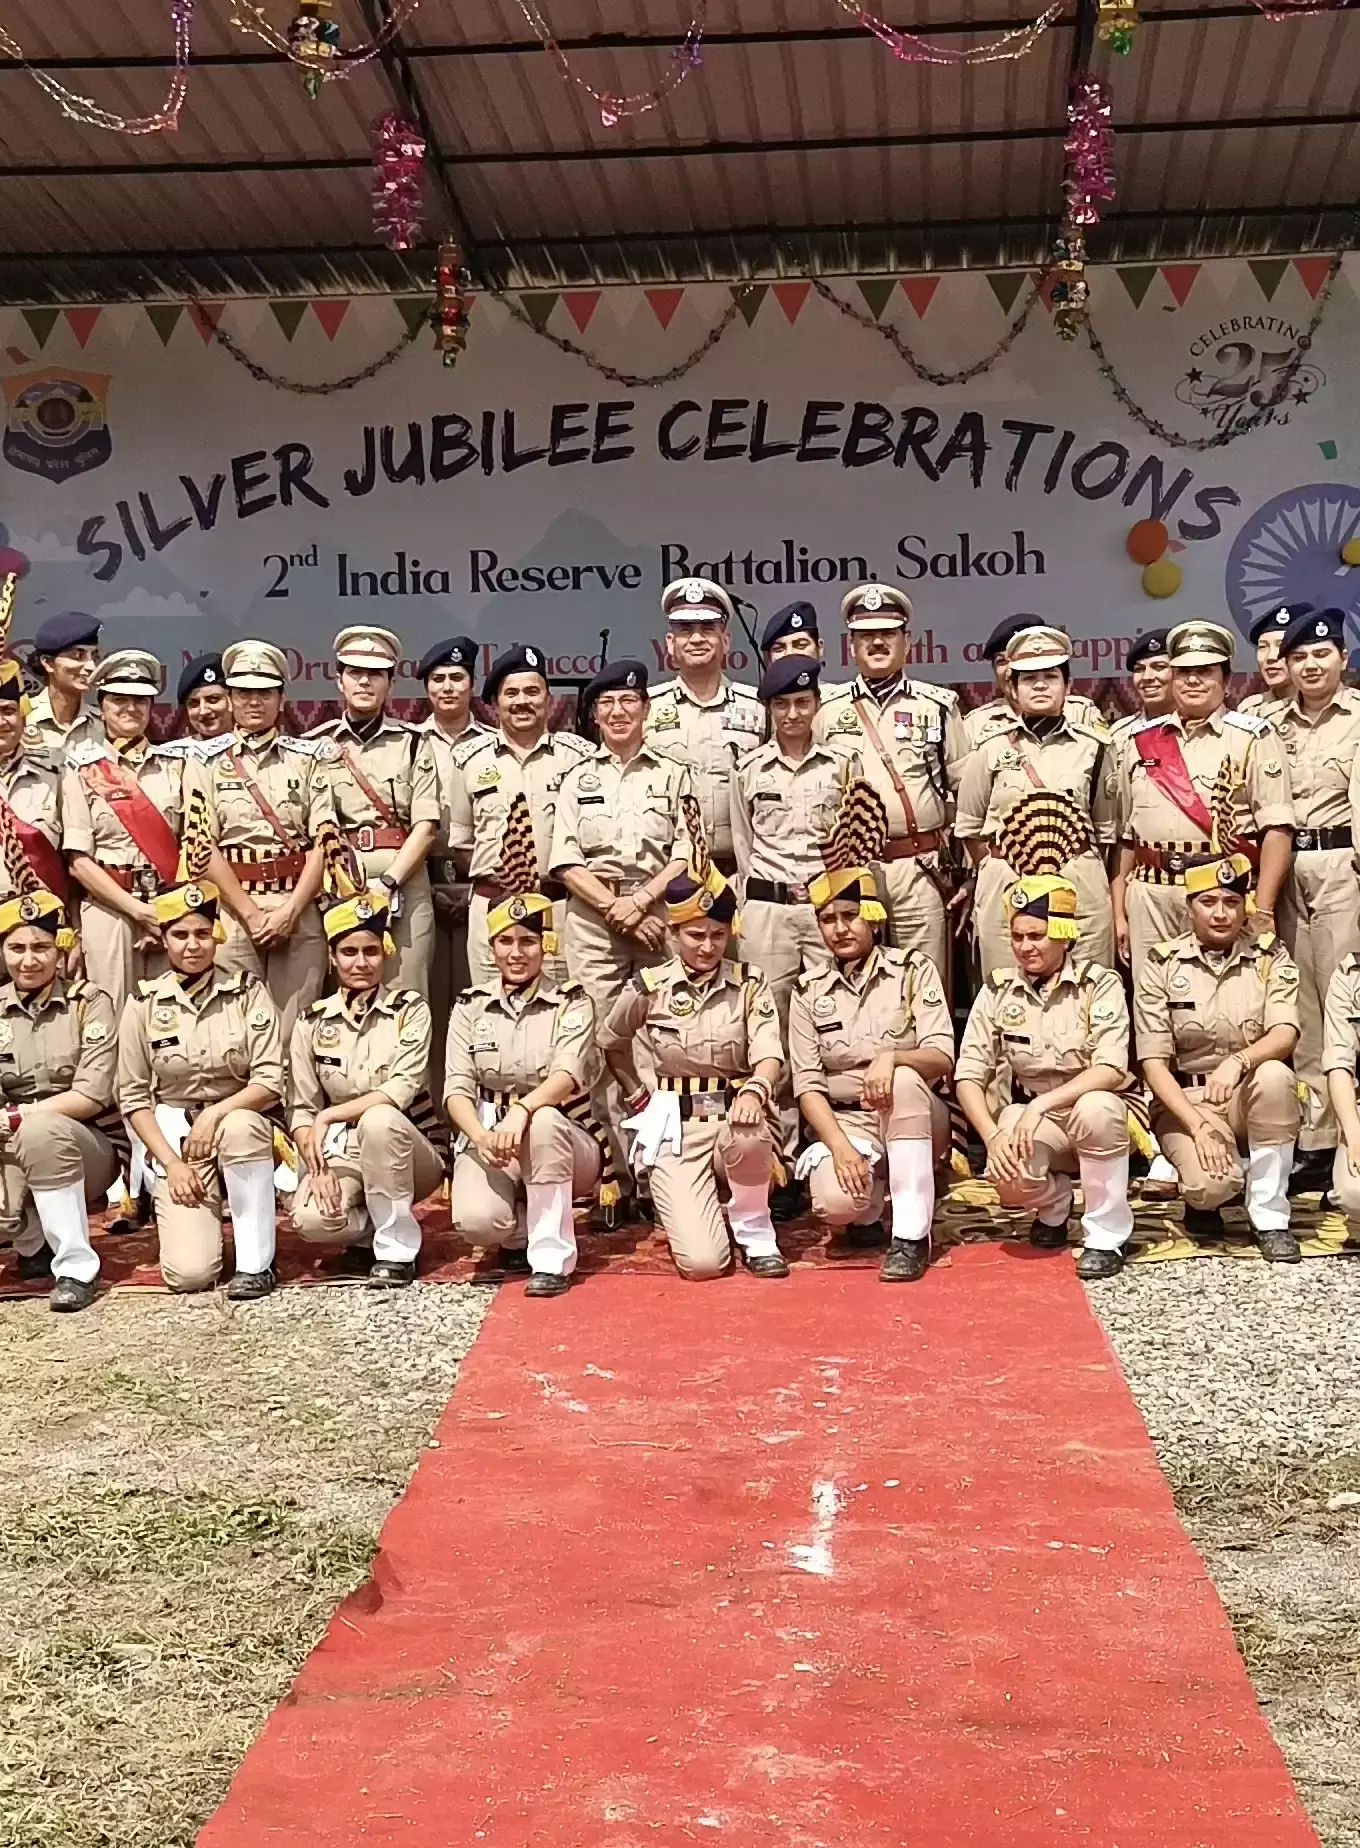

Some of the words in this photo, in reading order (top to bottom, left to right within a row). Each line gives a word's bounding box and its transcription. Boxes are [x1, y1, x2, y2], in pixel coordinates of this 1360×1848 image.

[1214, 341, 1297, 408] 25
[77, 442, 331, 582] SILVER
[343, 400, 635, 497] JUBILEE
[658, 398, 1242, 541] CELEBRATIONS
[263, 544, 318, 598] 2nd
[337, 551, 452, 597] India
[469, 549, 642, 594] Reserve
[895, 530, 1046, 580] Sakoh
